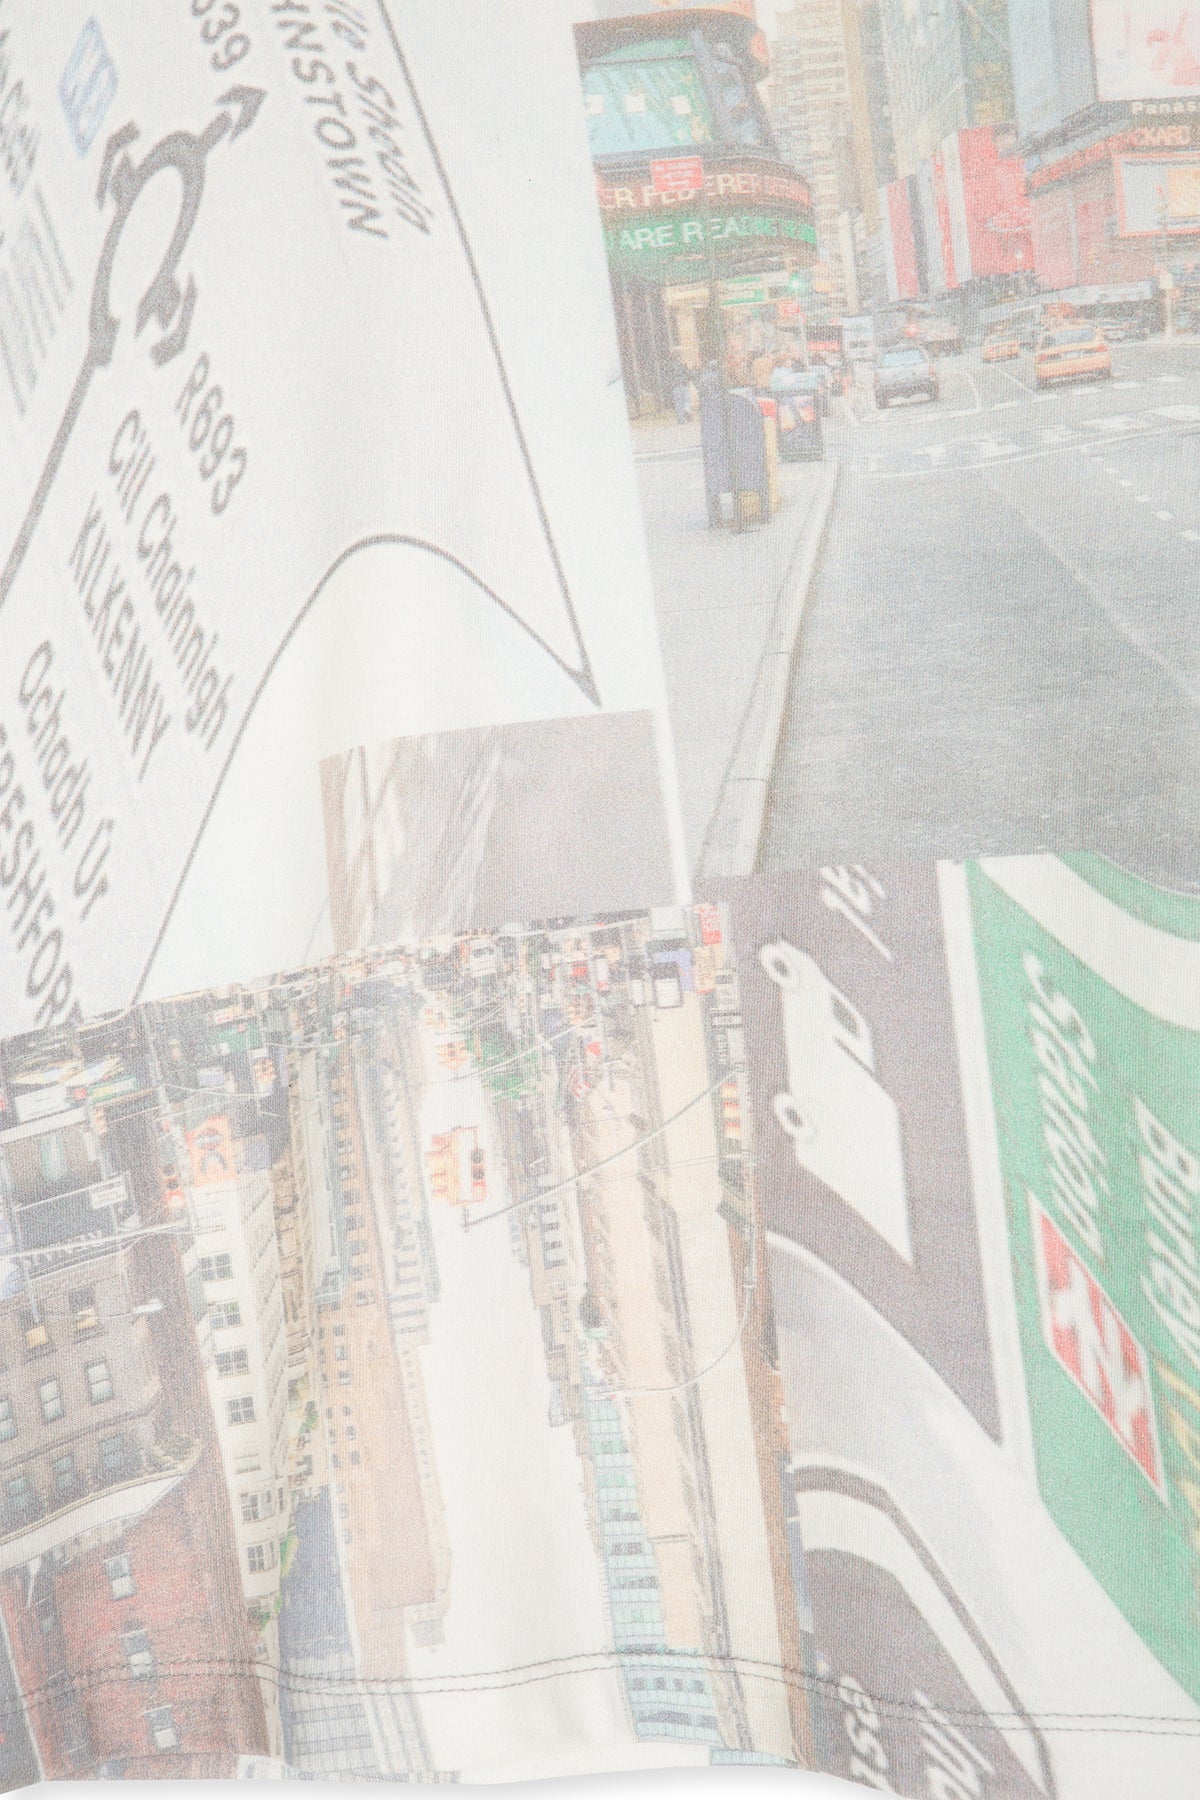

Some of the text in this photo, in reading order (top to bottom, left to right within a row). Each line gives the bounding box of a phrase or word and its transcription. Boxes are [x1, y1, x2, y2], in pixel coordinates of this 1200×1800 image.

[1131, 101, 1200, 115] Panas
[619, 224, 676, 250] ARE
[174, 352, 247, 516] R693
[69, 492, 174, 783] KILKENNY
[108, 408, 235, 751] Cill Chainnigh
[1023, 950, 1110, 1266] Station
